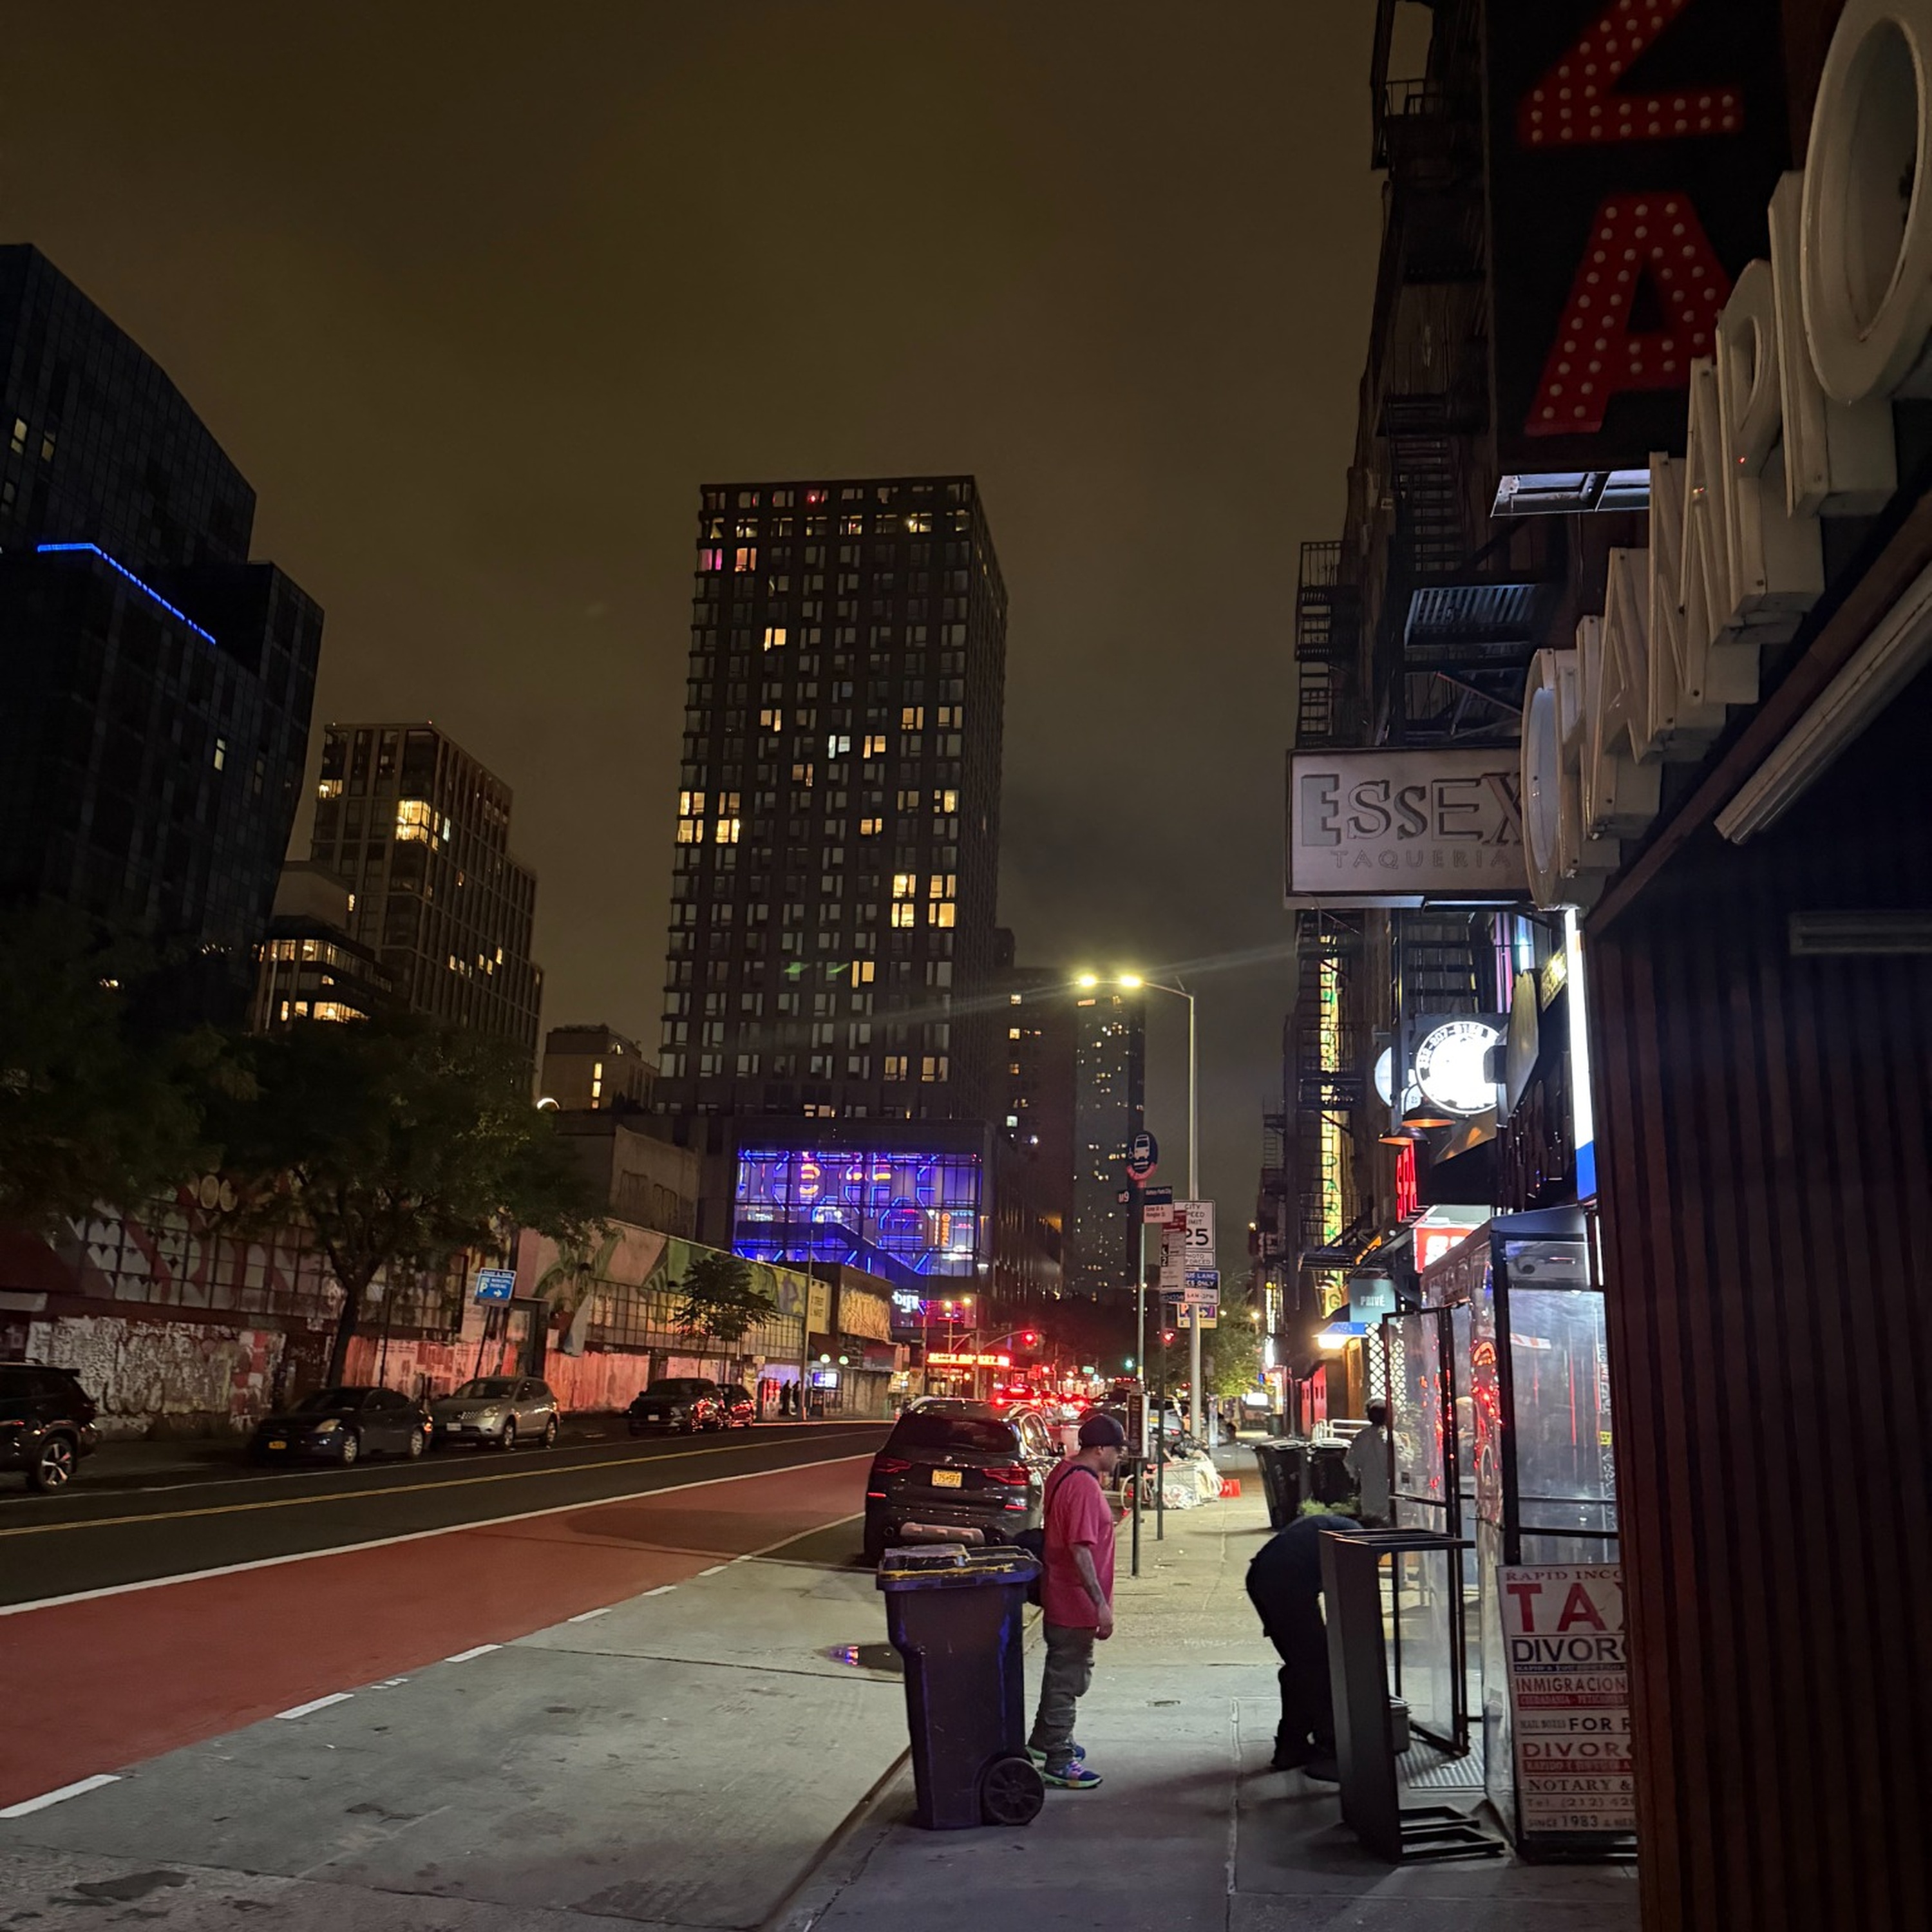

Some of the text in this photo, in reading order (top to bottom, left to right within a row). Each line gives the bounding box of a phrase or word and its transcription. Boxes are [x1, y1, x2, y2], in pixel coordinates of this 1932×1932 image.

[1301, 773, 1523, 846] ESSEX
[1330, 849, 1512, 869] TAQUERIA
[1186, 1228, 1209, 1246] 25
[1360, 1294, 1385, 1307] PRIVÉ
[1506, 1571, 1568, 1580] RAPID
[1511, 1638, 1627, 1662] DIVOR
[1516, 1677, 1625, 1692] INMIGRACION
[1569, 1718, 1612, 1731] FOR
[1523, 1743, 1631, 1757] DIVOR
[1528, 1779, 1631, 1791] NOTARY &
[1561, 1815, 1598, 1828] 1983
